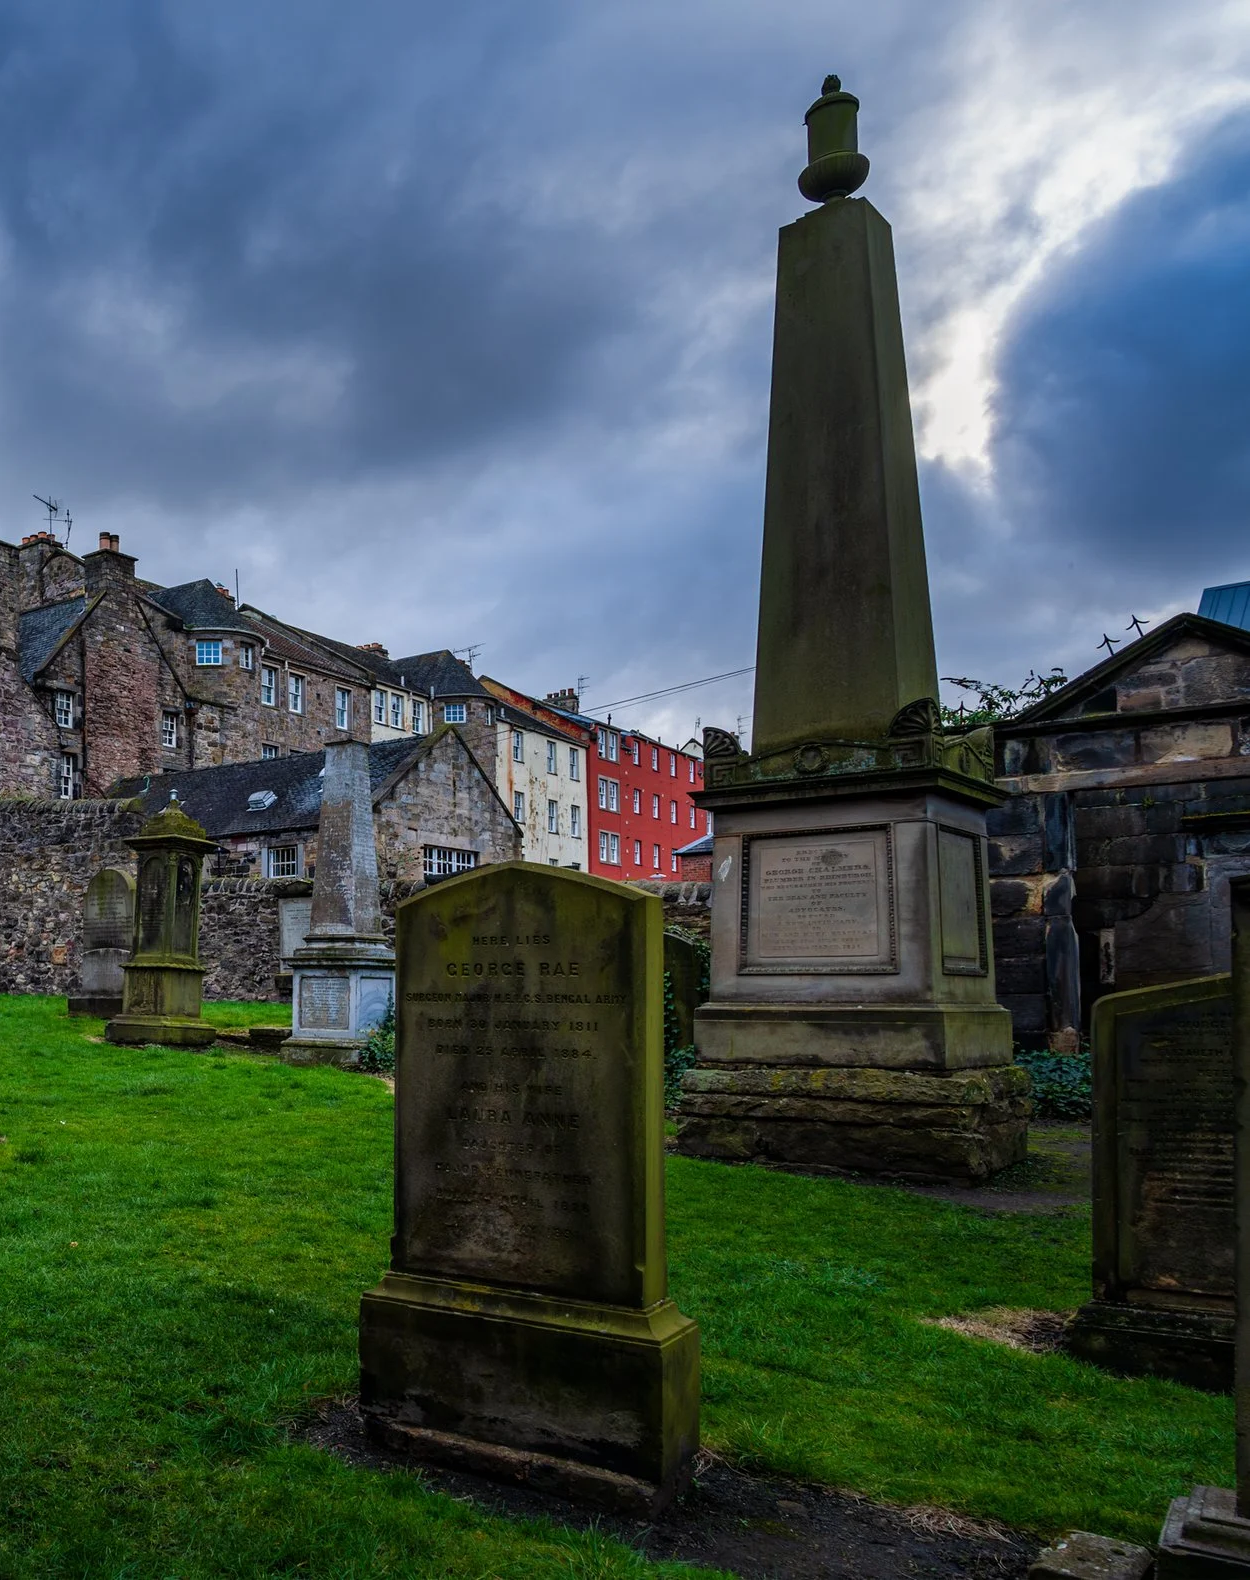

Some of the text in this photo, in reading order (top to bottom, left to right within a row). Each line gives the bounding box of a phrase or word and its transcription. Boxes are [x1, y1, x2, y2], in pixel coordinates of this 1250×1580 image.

[766, 868, 804, 876] GEORGE
[764, 876, 804, 884] PLUMBER
[472, 934, 550, 946] HERE LIES
[446, 962, 580, 978] GEORGE RAE
[406, 992, 450, 1003] SURGEON
[454, 992, 490, 1004] MAJOR
[546, 994, 590, 1005] BENGAL
[596, 994, 627, 1006] ARMY
[428, 1018, 462, 1030] BORN
[494, 1019, 560, 1032] JANUARY
[569, 1020, 598, 1032] 1811
[436, 1044, 469, 1056] DIED
[476, 1046, 493, 1056] 25
[502, 1046, 546, 1059] APRIL
[461, 1081, 562, 1096] AND HIS WIFE
[447, 1106, 580, 1132] LAURA ANNE
